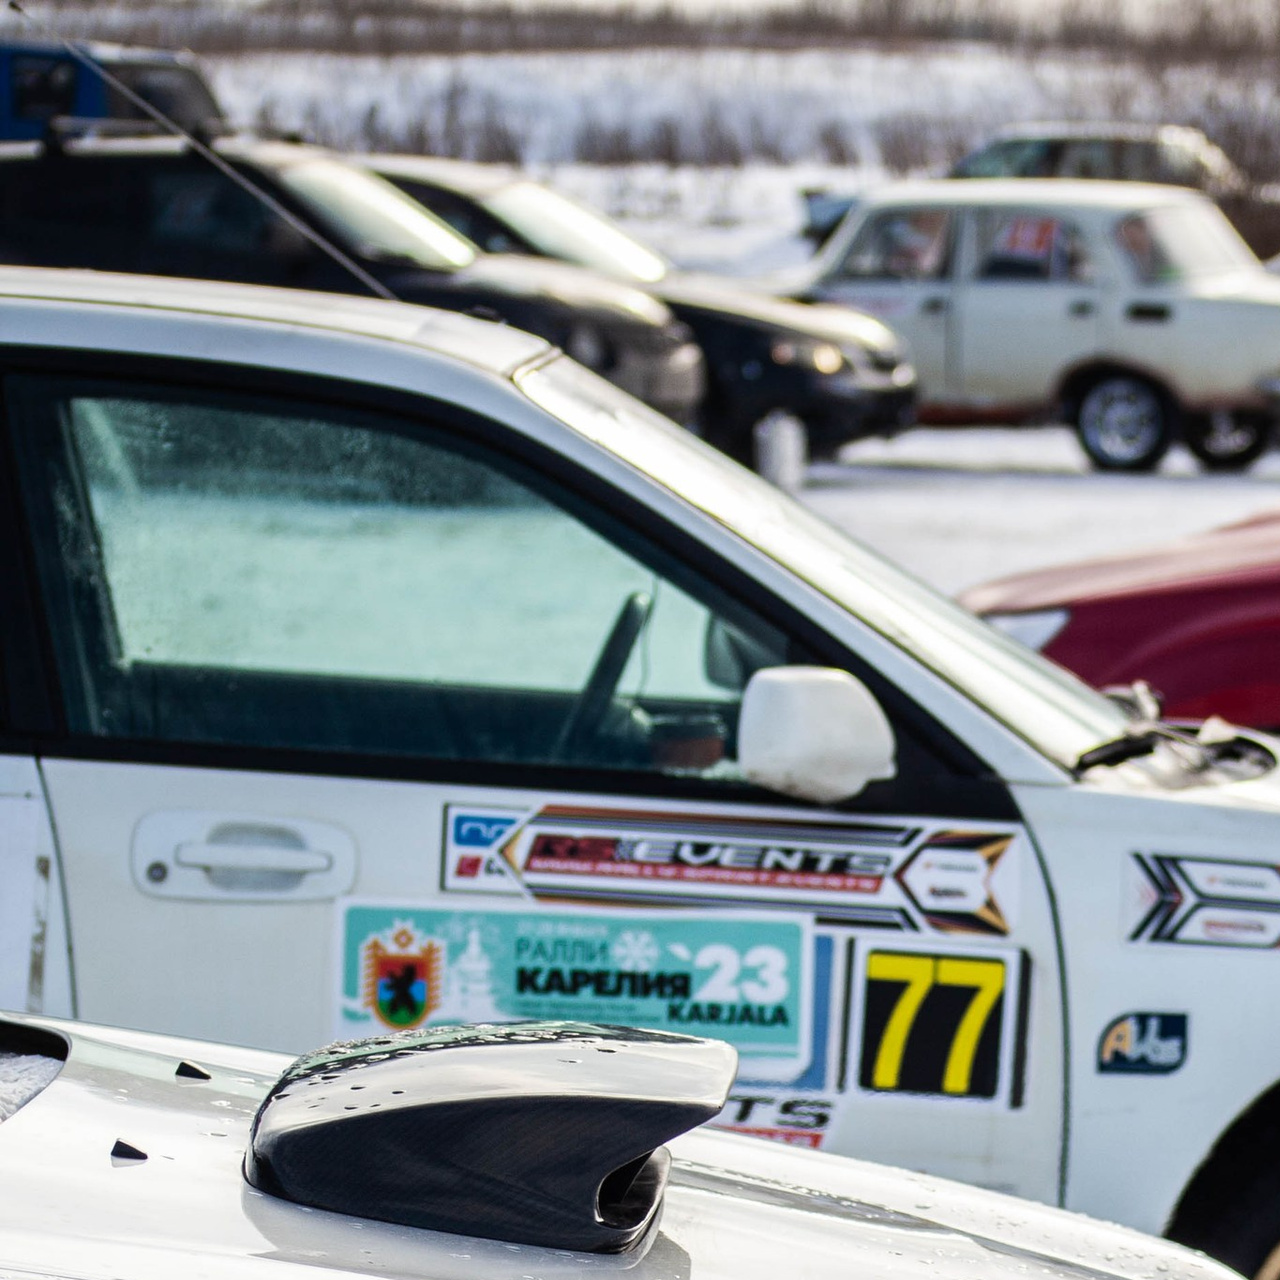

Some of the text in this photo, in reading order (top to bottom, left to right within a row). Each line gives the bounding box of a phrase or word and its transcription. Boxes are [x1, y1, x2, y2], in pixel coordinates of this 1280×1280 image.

[515, 937, 608, 964] РАЛЛИ
[516, 967, 691, 1000] КАРЕЛИЯ
[667, 1002, 790, 1027] KARJALA
[866, 952, 1005, 1093] 77
